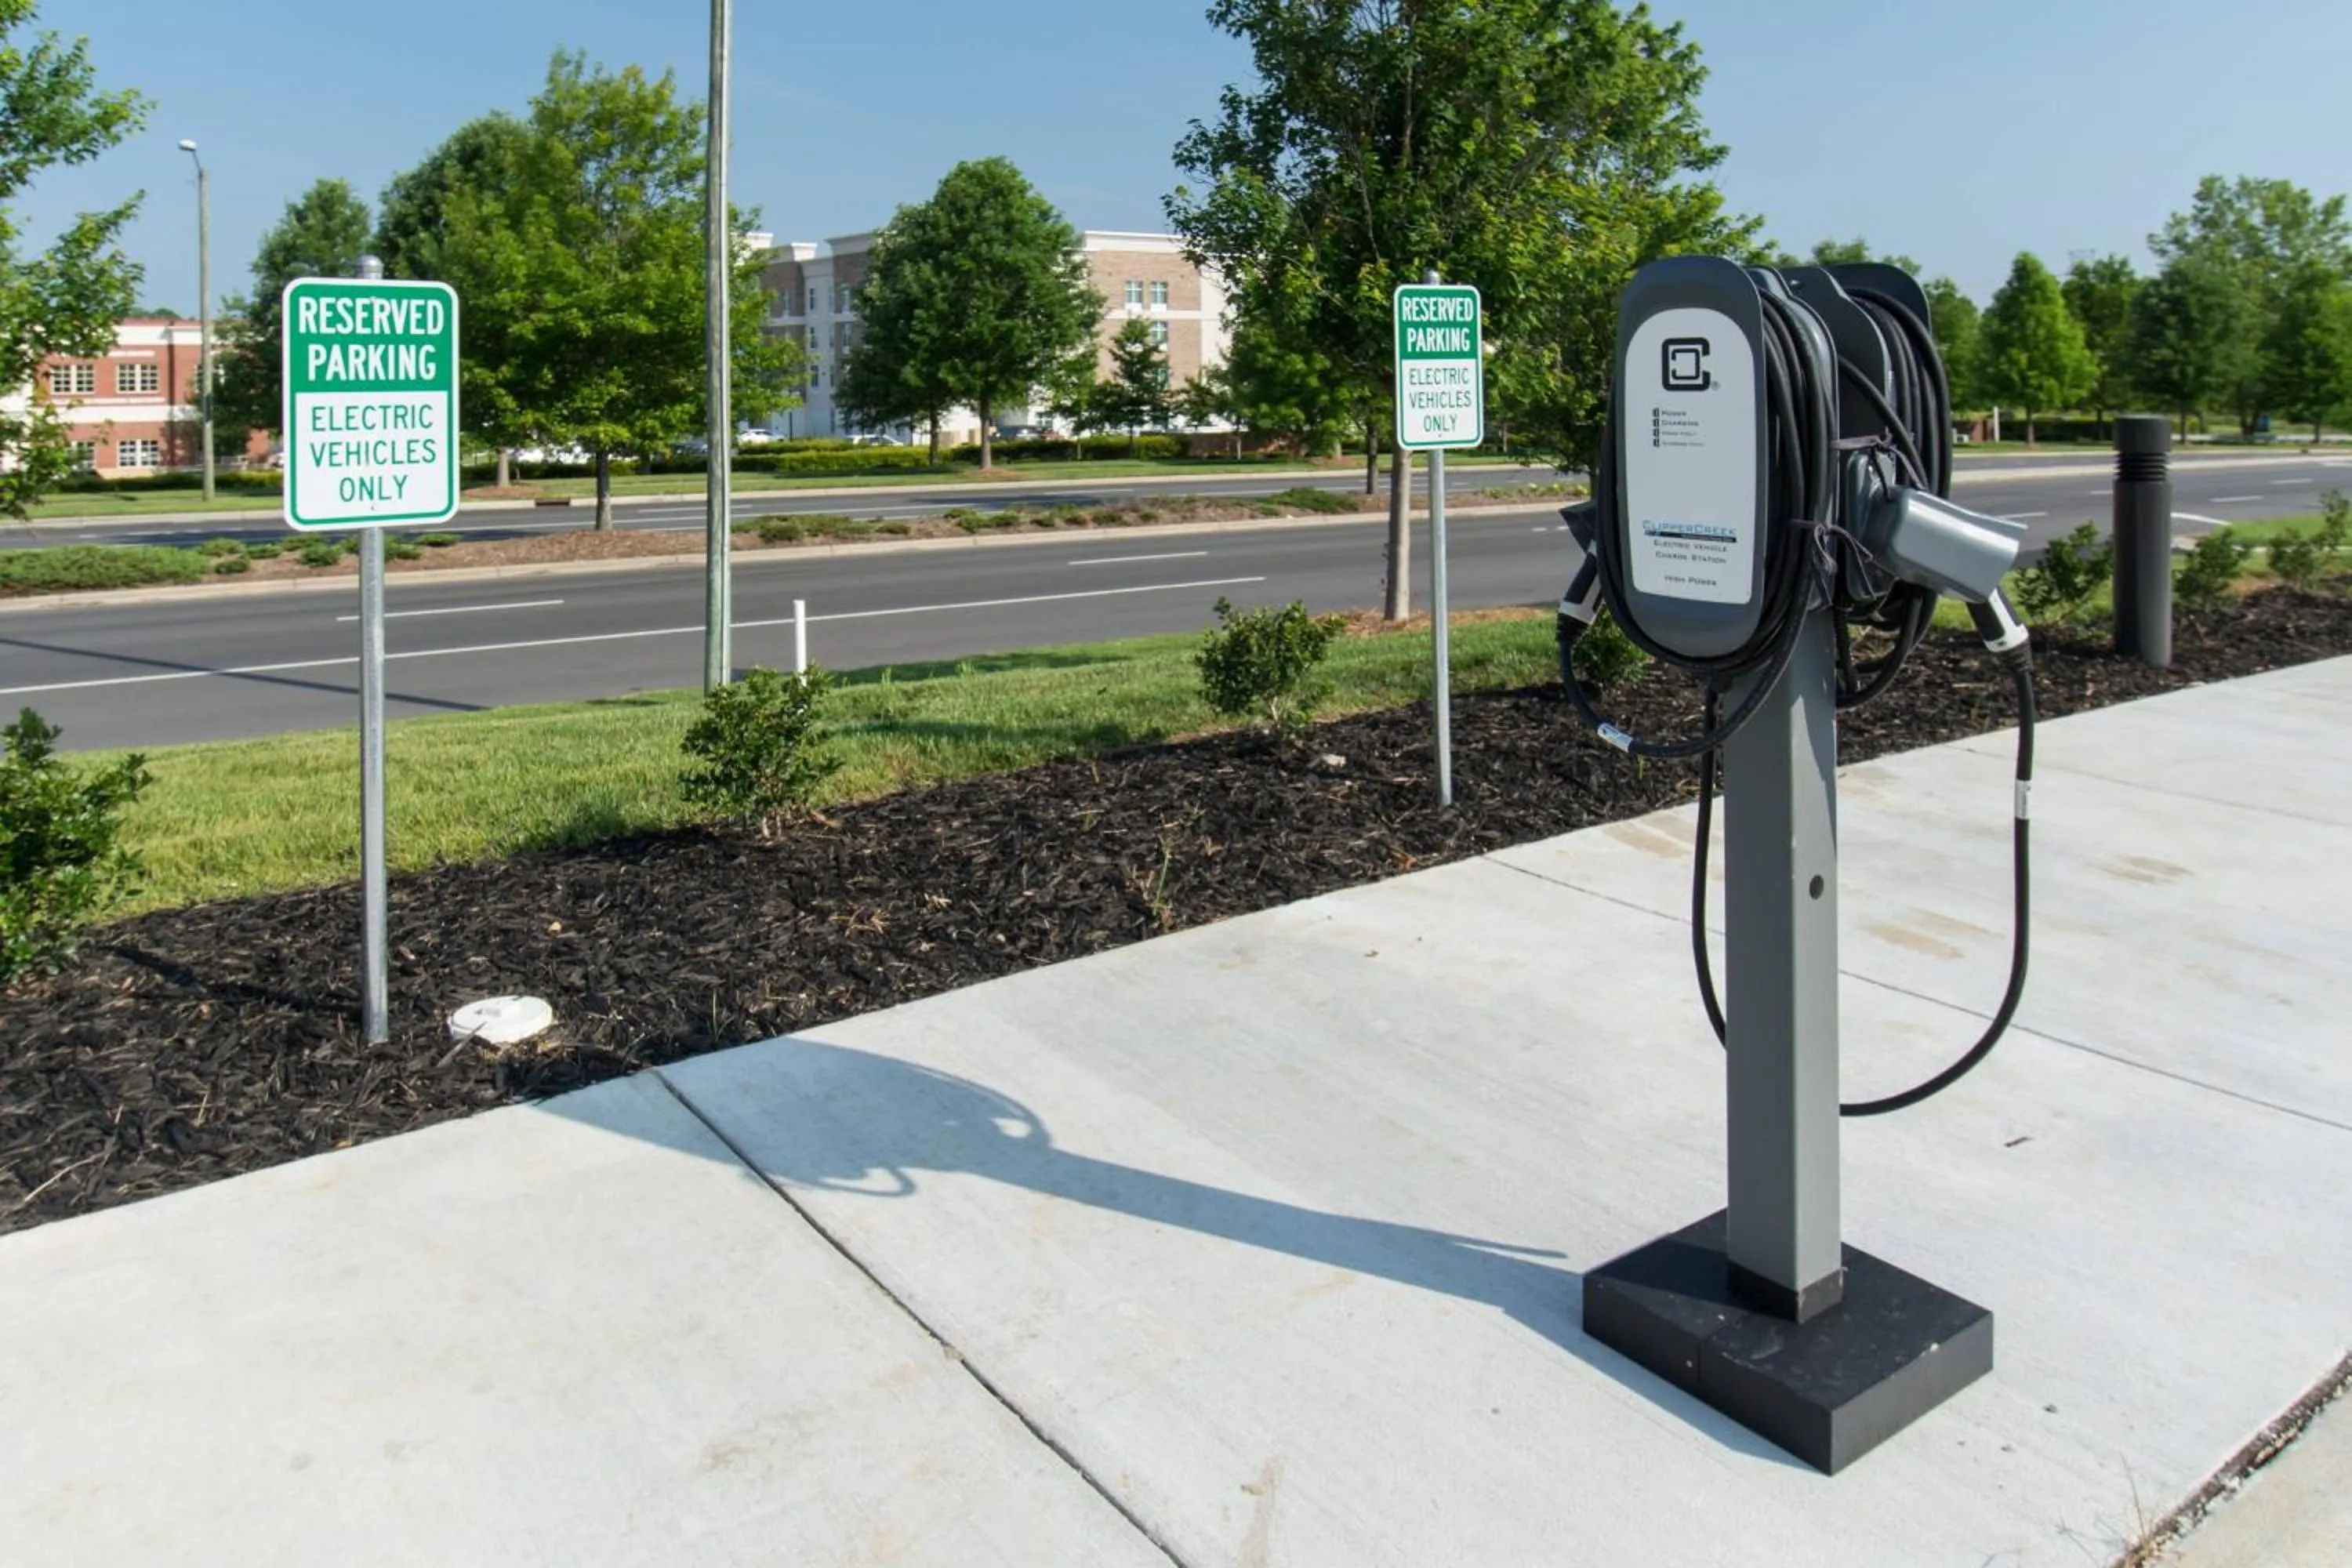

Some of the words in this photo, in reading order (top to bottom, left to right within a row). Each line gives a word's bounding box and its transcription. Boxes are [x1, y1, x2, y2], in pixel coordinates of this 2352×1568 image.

[299, 296, 445, 335] RESERVED
[1402, 297, 1474, 322] RESERVED
[1406, 327, 1471, 352] PARKING
[308, 344, 436, 381] PARKING
[1410, 368, 1468, 385] ELECTRIC
[1409, 390, 1472, 408] VEHICLES
[311, 405, 434, 432] ELECTRIC
[1423, 415, 1457, 432] ONLY
[310, 439, 436, 468] VEHICLES
[339, 474, 408, 502] ONLY
